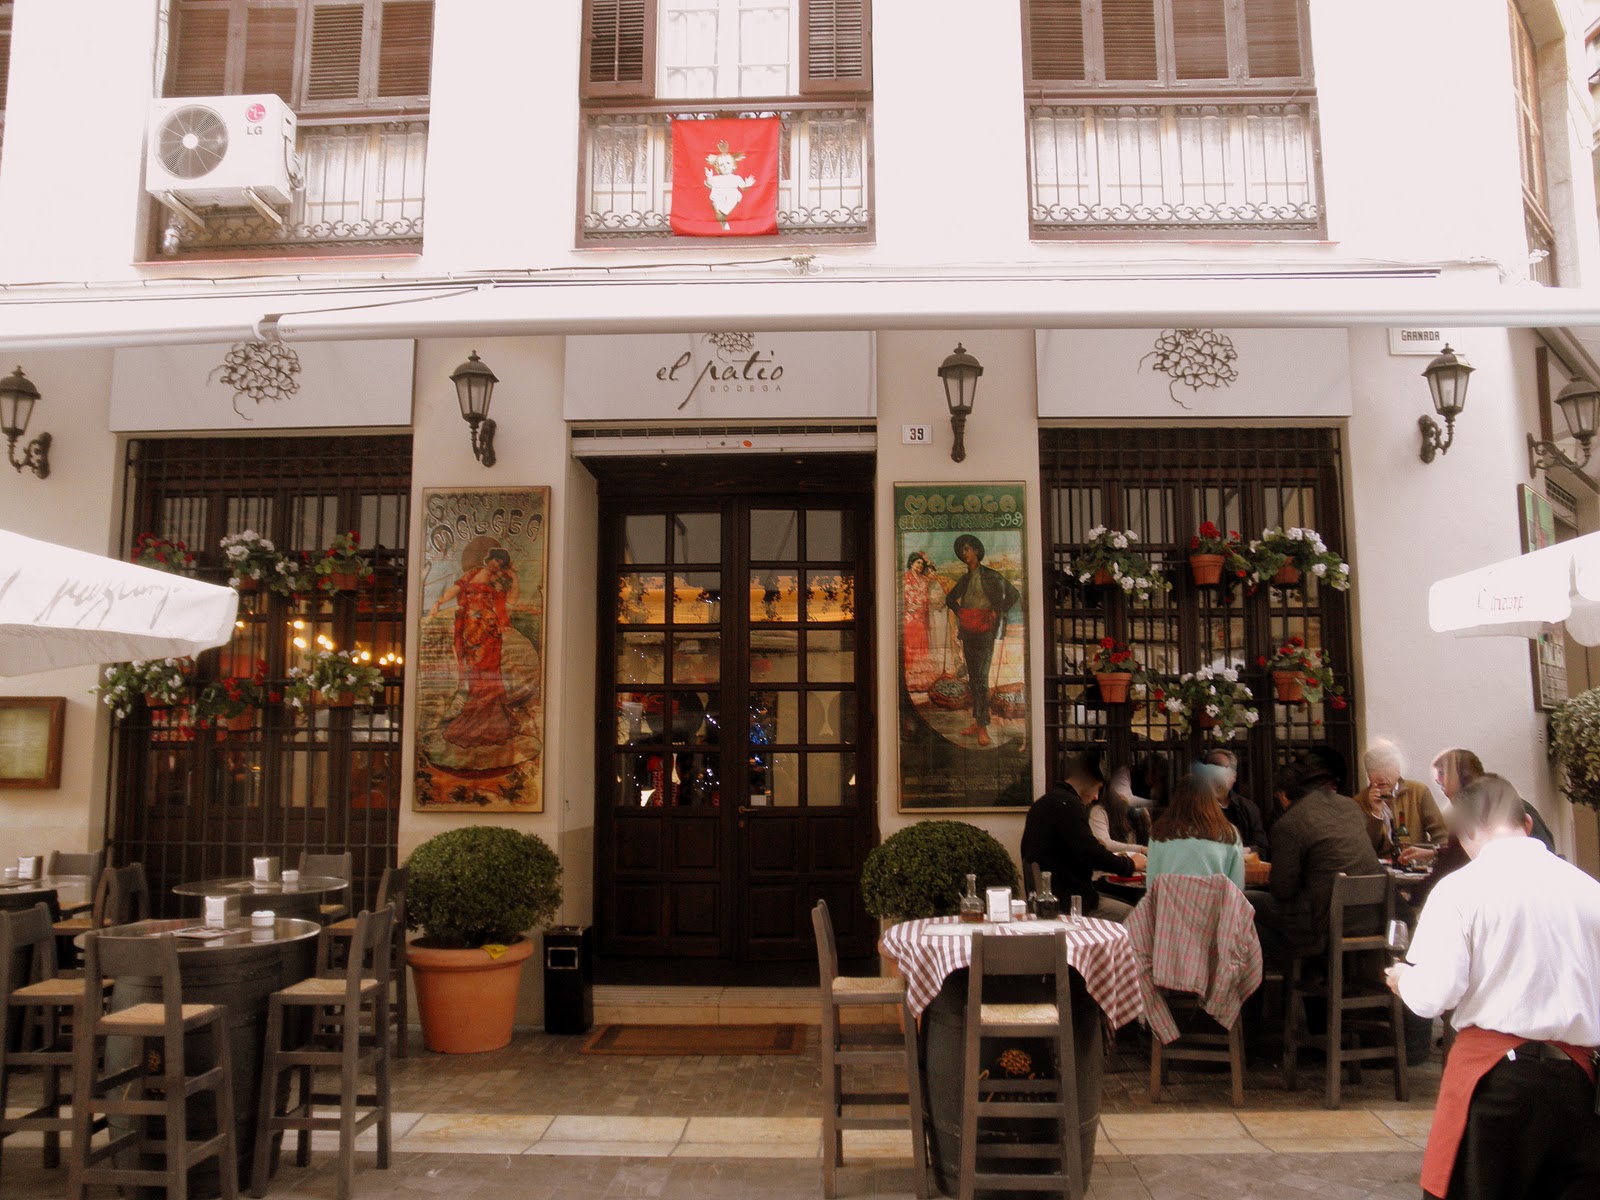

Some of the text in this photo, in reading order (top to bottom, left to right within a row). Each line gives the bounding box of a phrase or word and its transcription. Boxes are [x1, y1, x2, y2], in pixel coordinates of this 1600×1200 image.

[246, 126, 262, 135] LG
[1401, 330, 1440, 341] GRANADA
[656, 350, 784, 410] el patio
[709, 385, 782, 393] BODEGA
[909, 427, 924, 441] 39
